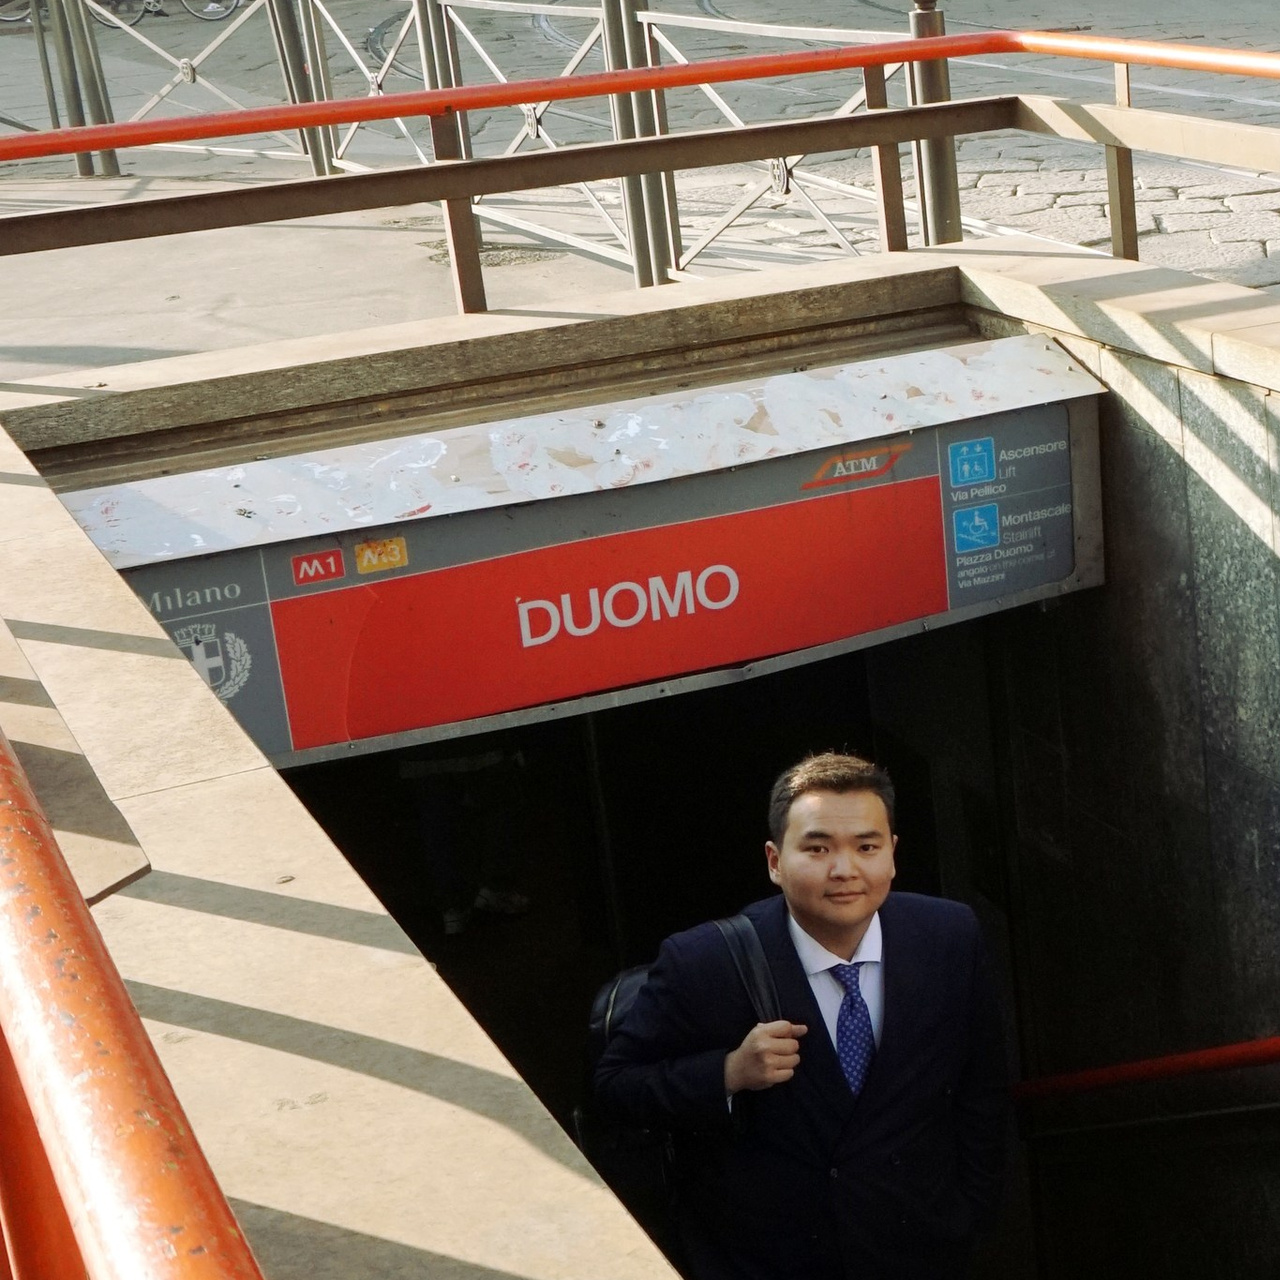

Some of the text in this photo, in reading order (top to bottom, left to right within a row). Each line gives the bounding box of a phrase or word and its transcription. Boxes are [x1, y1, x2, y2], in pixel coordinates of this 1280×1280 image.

[1000, 440, 1067, 461] Ascensore
[834, 455, 879, 478] ATM
[999, 466, 1016, 480] Lift
[951, 484, 1006, 502] Via Pellico
[1002, 503, 1071, 527] Montascale
[1003, 526, 1042, 545] Stairlift
[362, 544, 401, 567] M3
[956, 543, 1033, 567] Piazza Duomo
[299, 556, 336, 580] M1
[957, 564, 988, 578] angolo
[1003, 558, 1016, 569] the
[958, 573, 1005, 589] Via Mazzini
[517, 564, 739, 648] DUOMO
